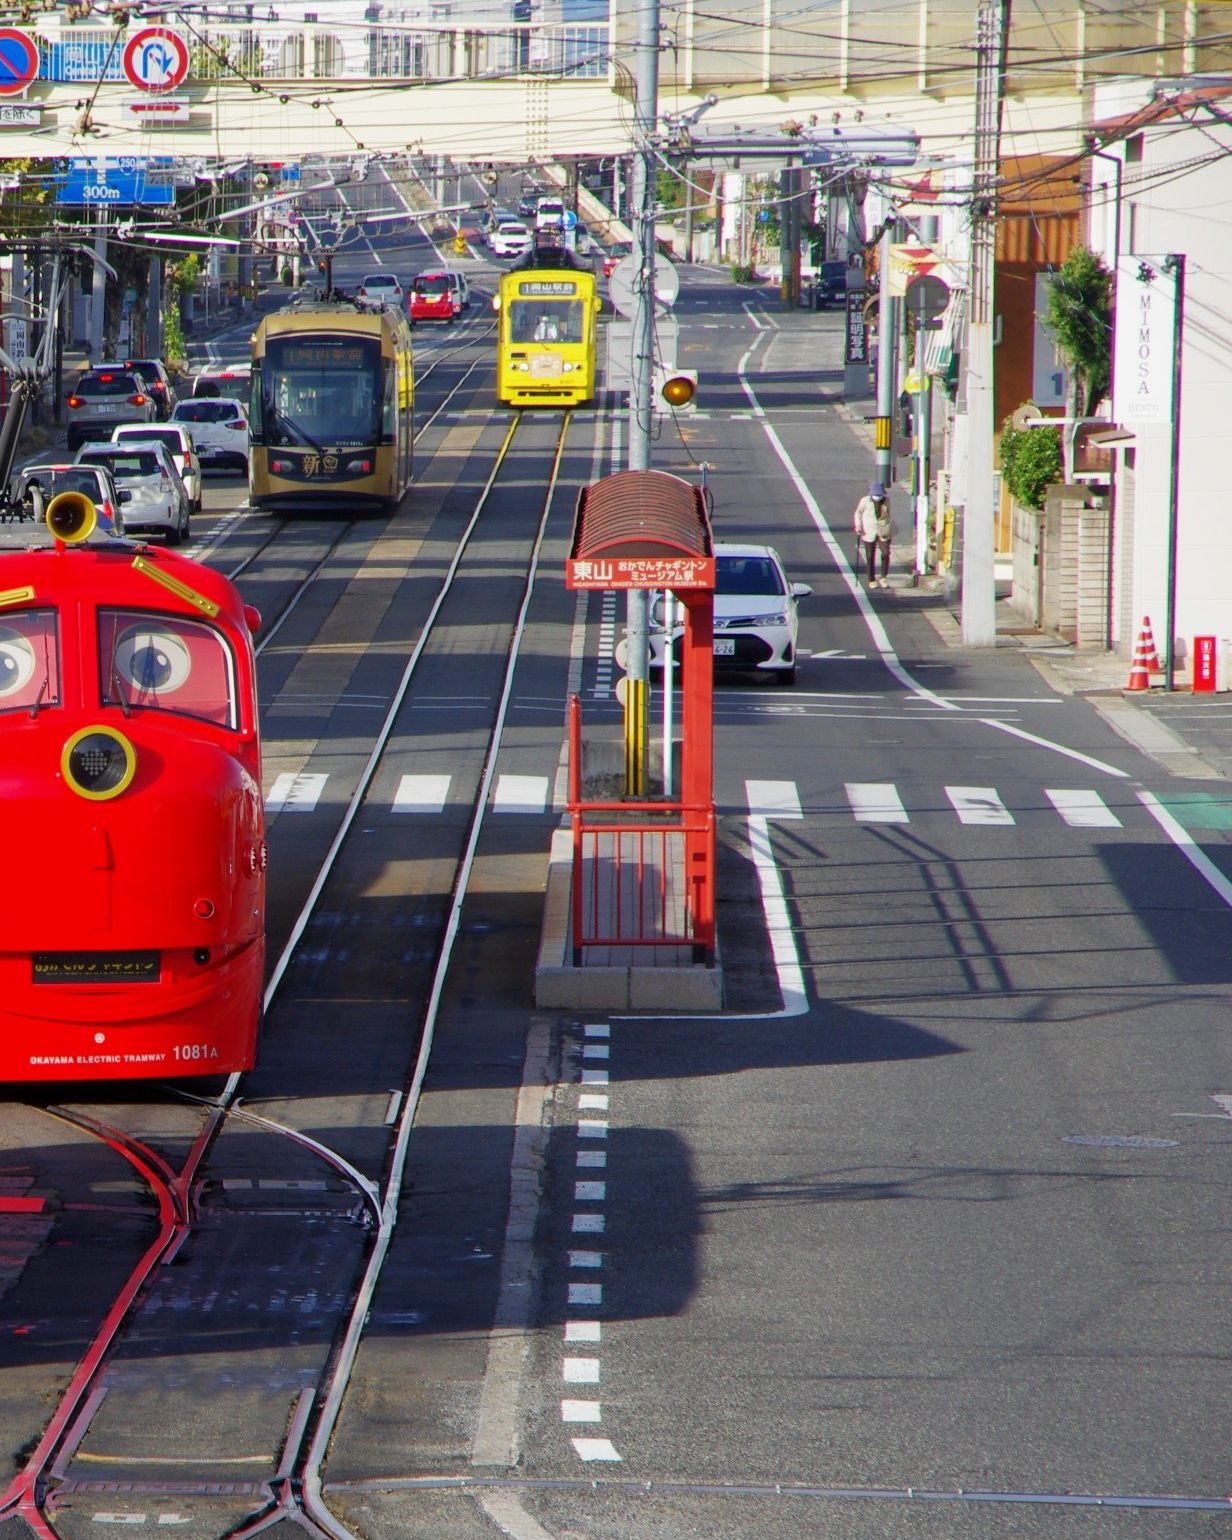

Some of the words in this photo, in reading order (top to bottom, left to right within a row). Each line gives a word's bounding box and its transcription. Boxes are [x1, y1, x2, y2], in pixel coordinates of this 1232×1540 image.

[120, 157, 135, 168] 250
[82, 186, 120, 199] 300m
[850, 312, 864, 360] 証明写真
[1138, 294, 1151, 395] MIMOSA
[572, 560, 613, 581] 東山
[618, 560, 707, 572] おかでんチャギントン
[631, 571, 694, 582] ミュージアム駅
[30, 1056, 74, 1064] OKAYAMA
[76, 1055, 121, 1064] ELECTRIC
[125, 1053, 166, 1062] TRAMWAY
